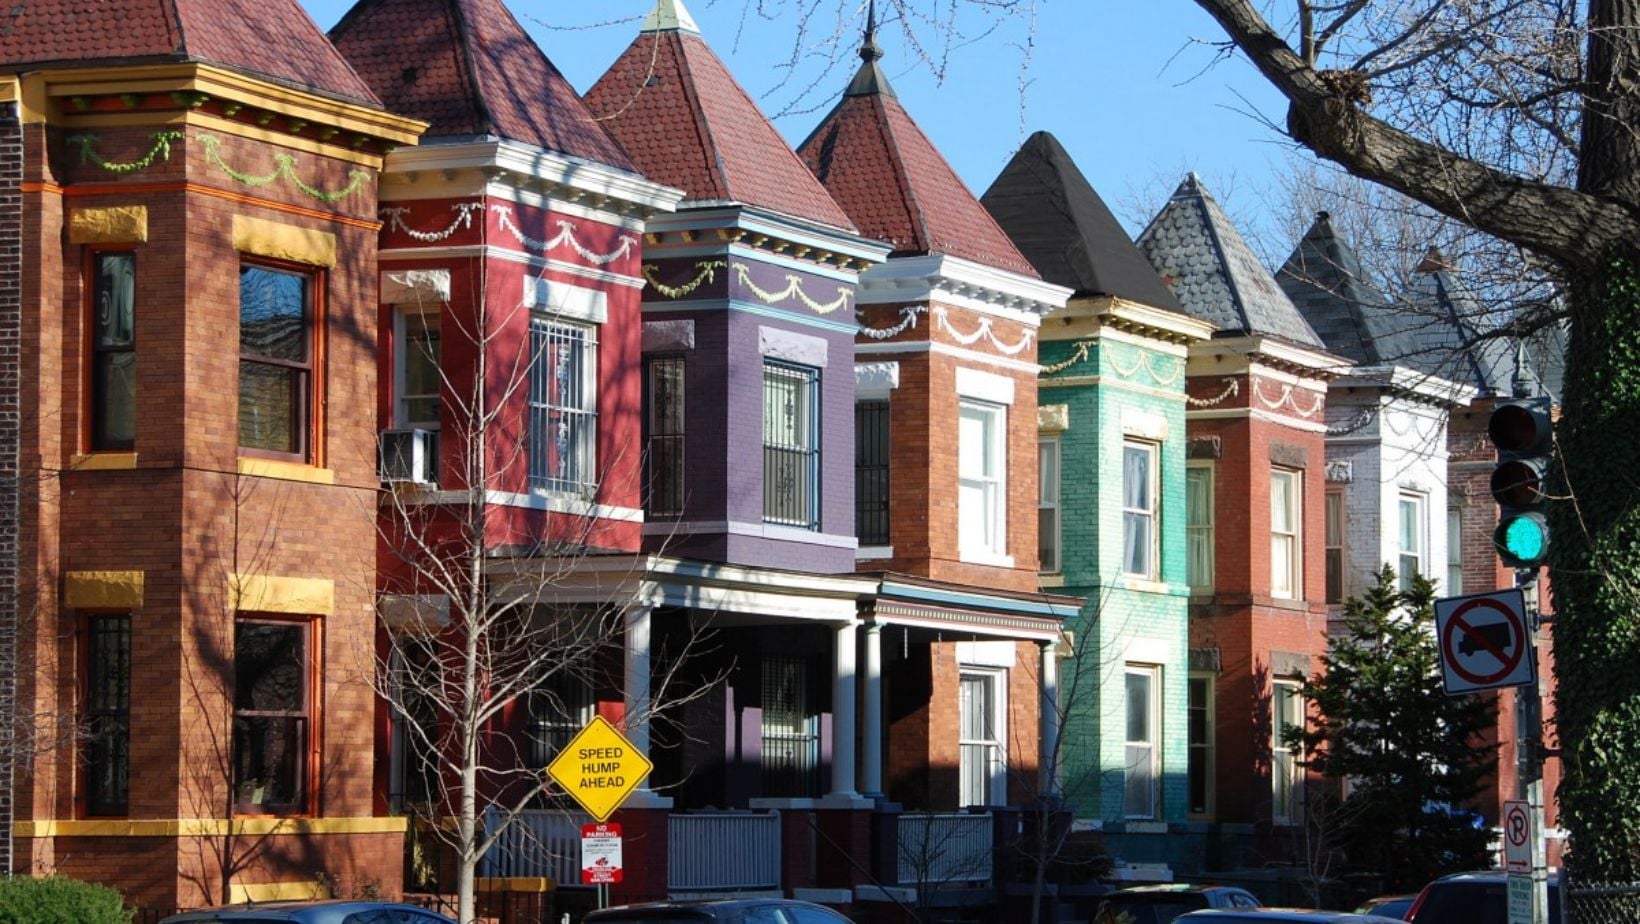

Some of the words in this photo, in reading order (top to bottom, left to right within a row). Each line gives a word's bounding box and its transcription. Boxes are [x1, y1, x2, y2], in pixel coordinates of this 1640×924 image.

[579, 748, 623, 760] SPEED
[582, 762, 621, 774] HUMP
[579, 776, 625, 788] AHEAD
